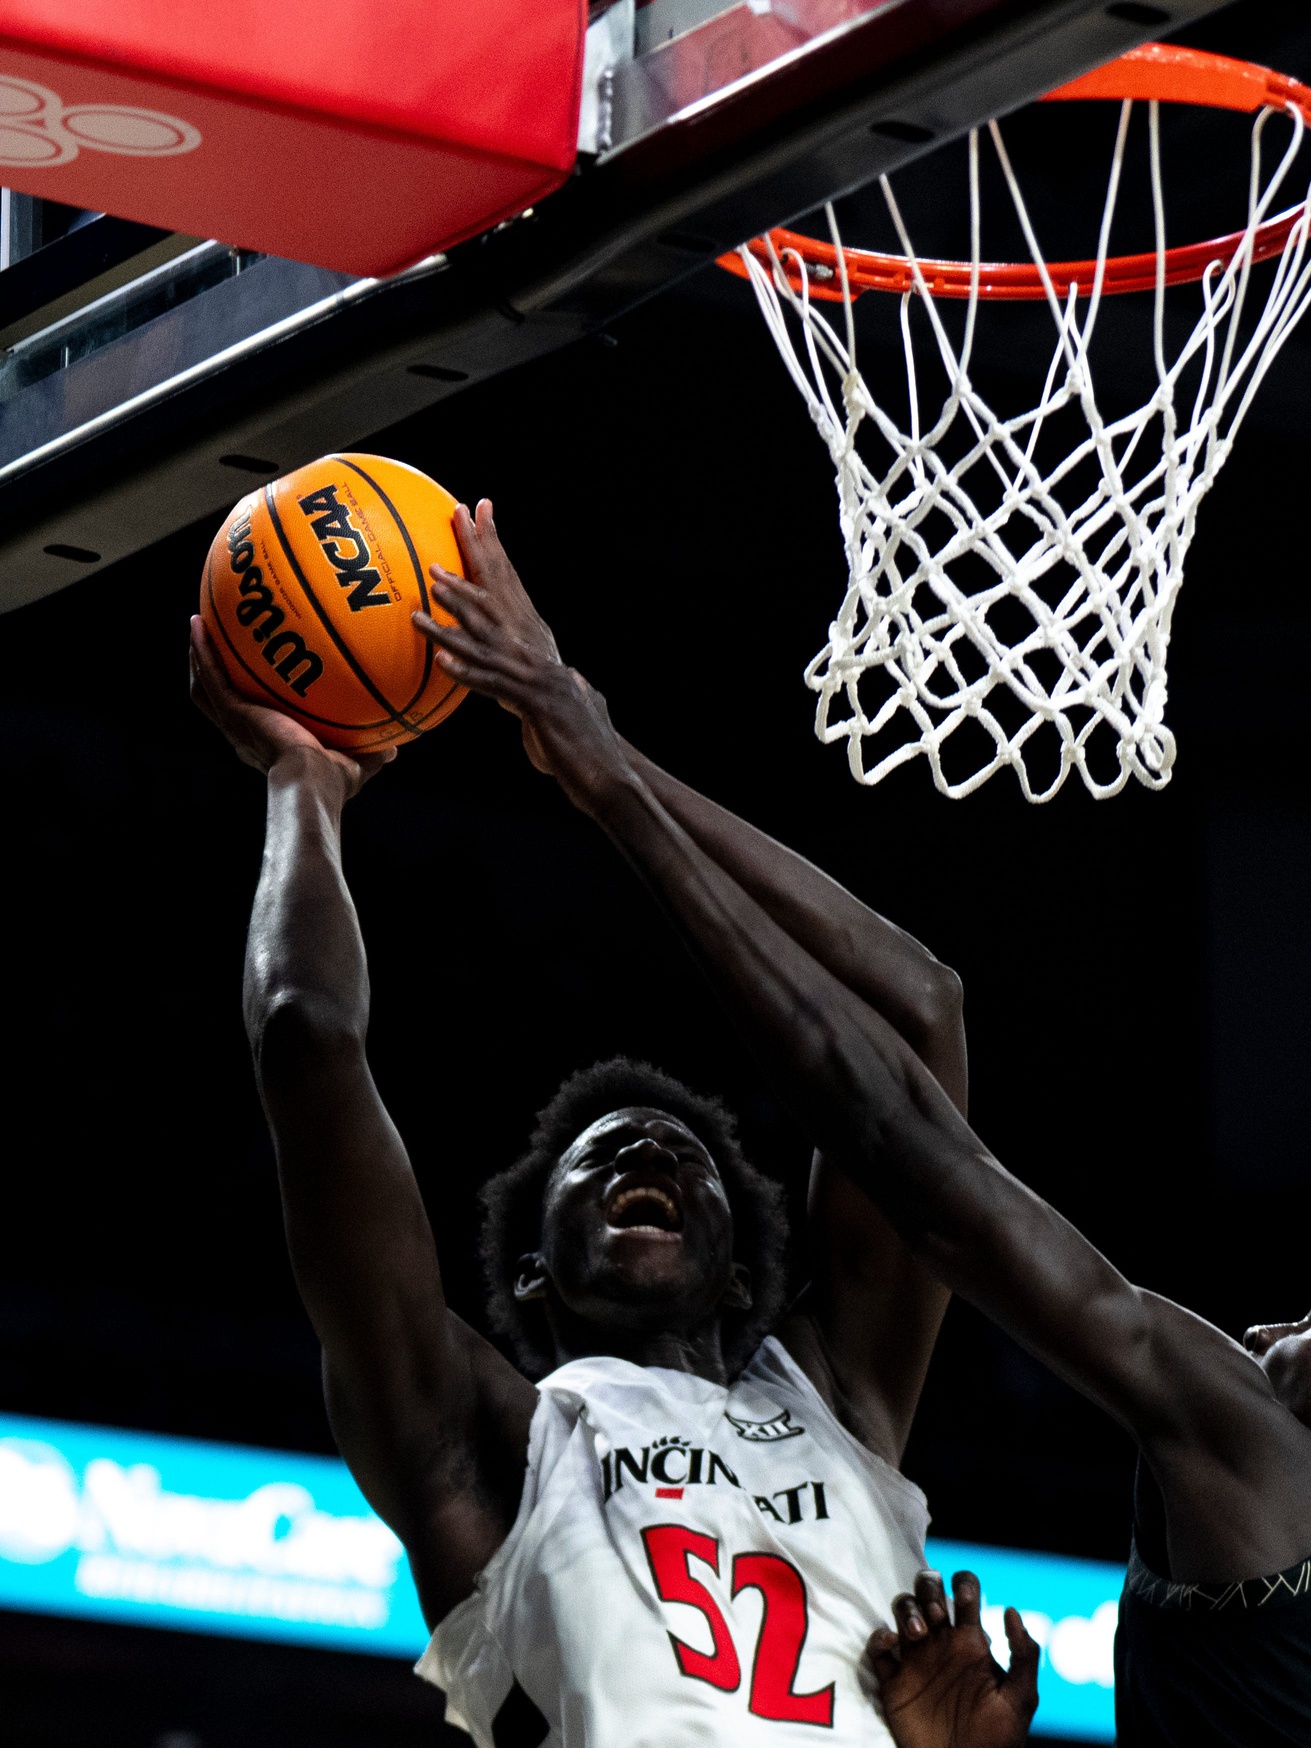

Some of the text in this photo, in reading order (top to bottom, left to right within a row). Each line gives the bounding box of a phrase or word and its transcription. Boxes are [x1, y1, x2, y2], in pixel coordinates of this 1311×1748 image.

[226, 503, 324, 699] Wilson
[279, 586, 302, 619] INDOOR
[297, 483, 393, 613] NCAA
[342, 482, 402, 602] OFFICIAL GAME BALL
[600, 1437, 830, 1525] INCINATI
[639, 1522, 836, 1729] 52
